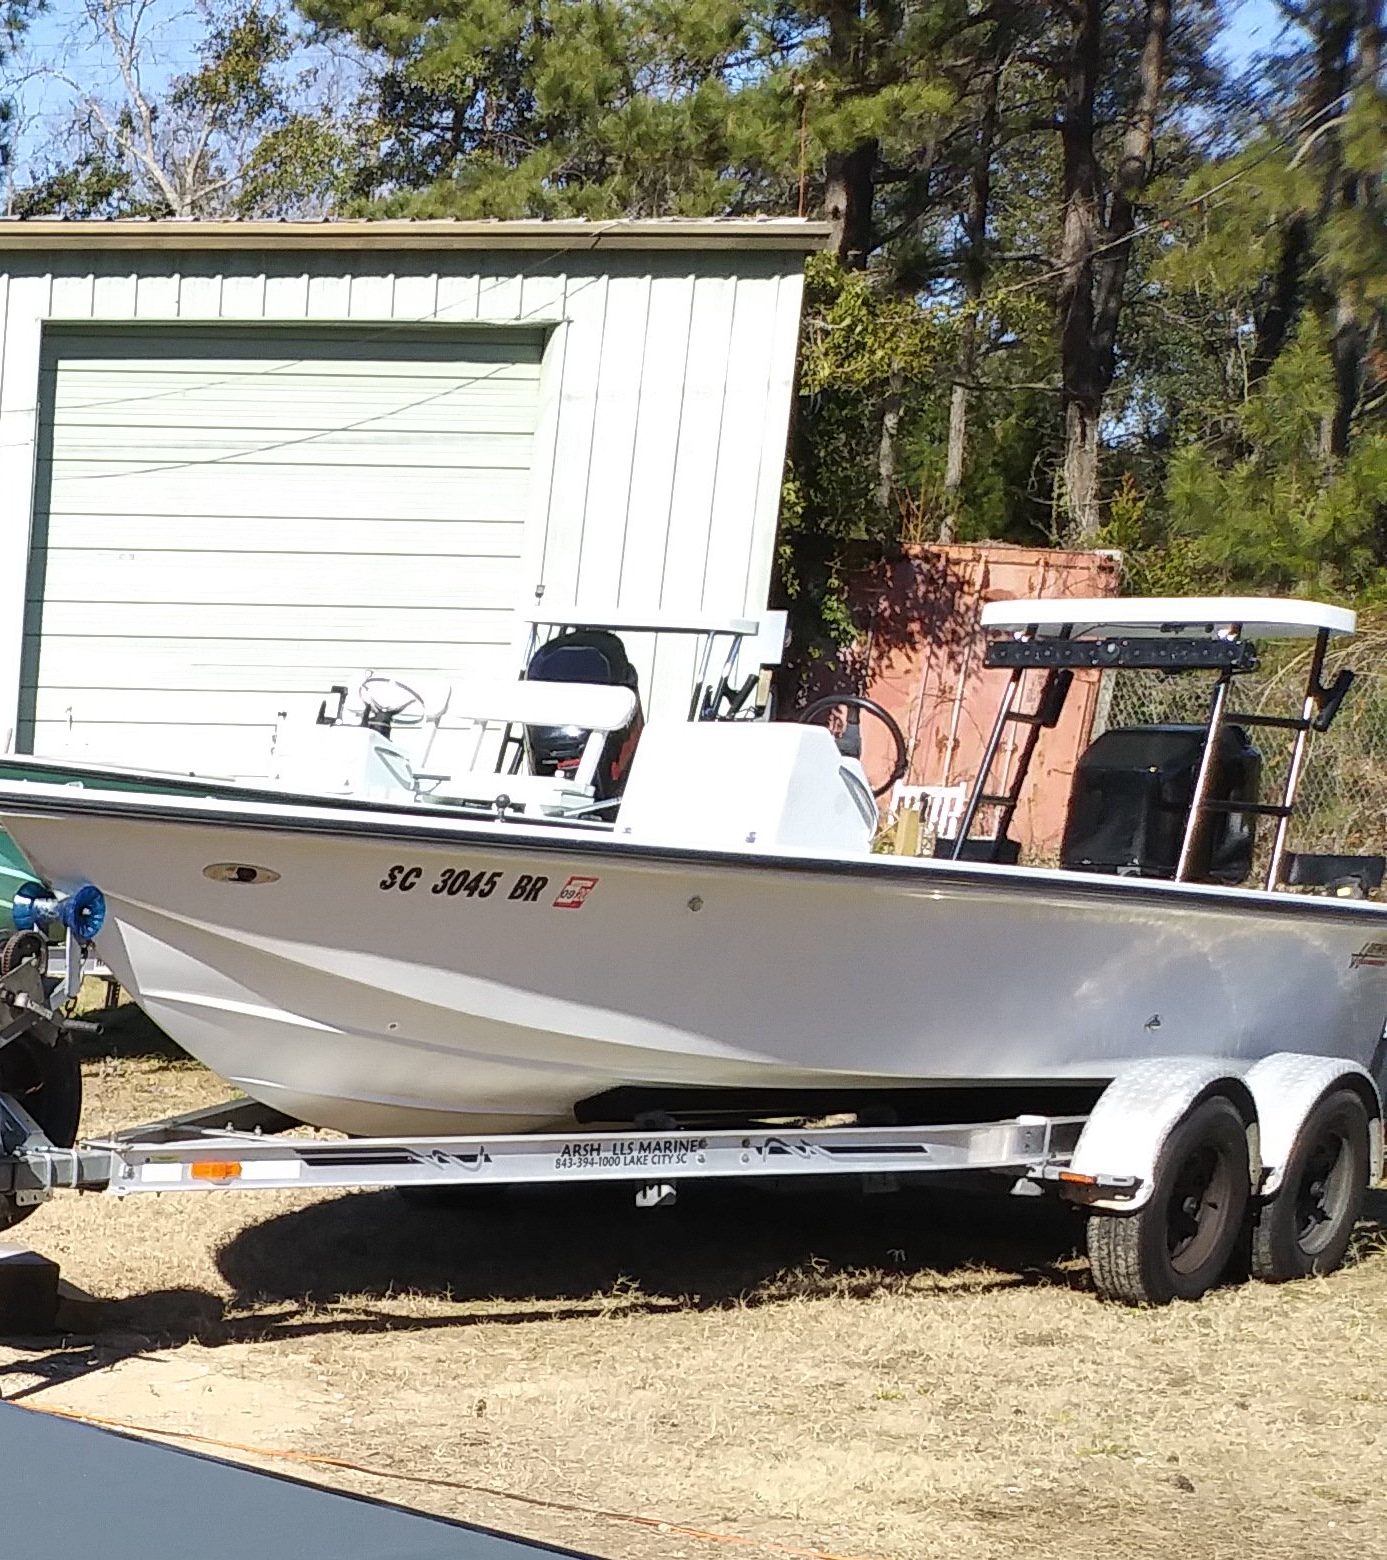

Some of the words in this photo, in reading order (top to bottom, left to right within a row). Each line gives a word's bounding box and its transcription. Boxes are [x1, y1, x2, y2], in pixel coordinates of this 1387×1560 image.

[379, 865, 422, 891] SC
[431, 868, 503, 898] 3045
[508, 875, 549, 902] BR
[638, 1140, 698, 1154] MARINE
[555, 1156, 620, 1169] 843-394-1000
[624, 1155, 648, 1166] LAKE
[651, 1154, 674, 1165] CITY
[676, 1153, 687, 1164] SC
